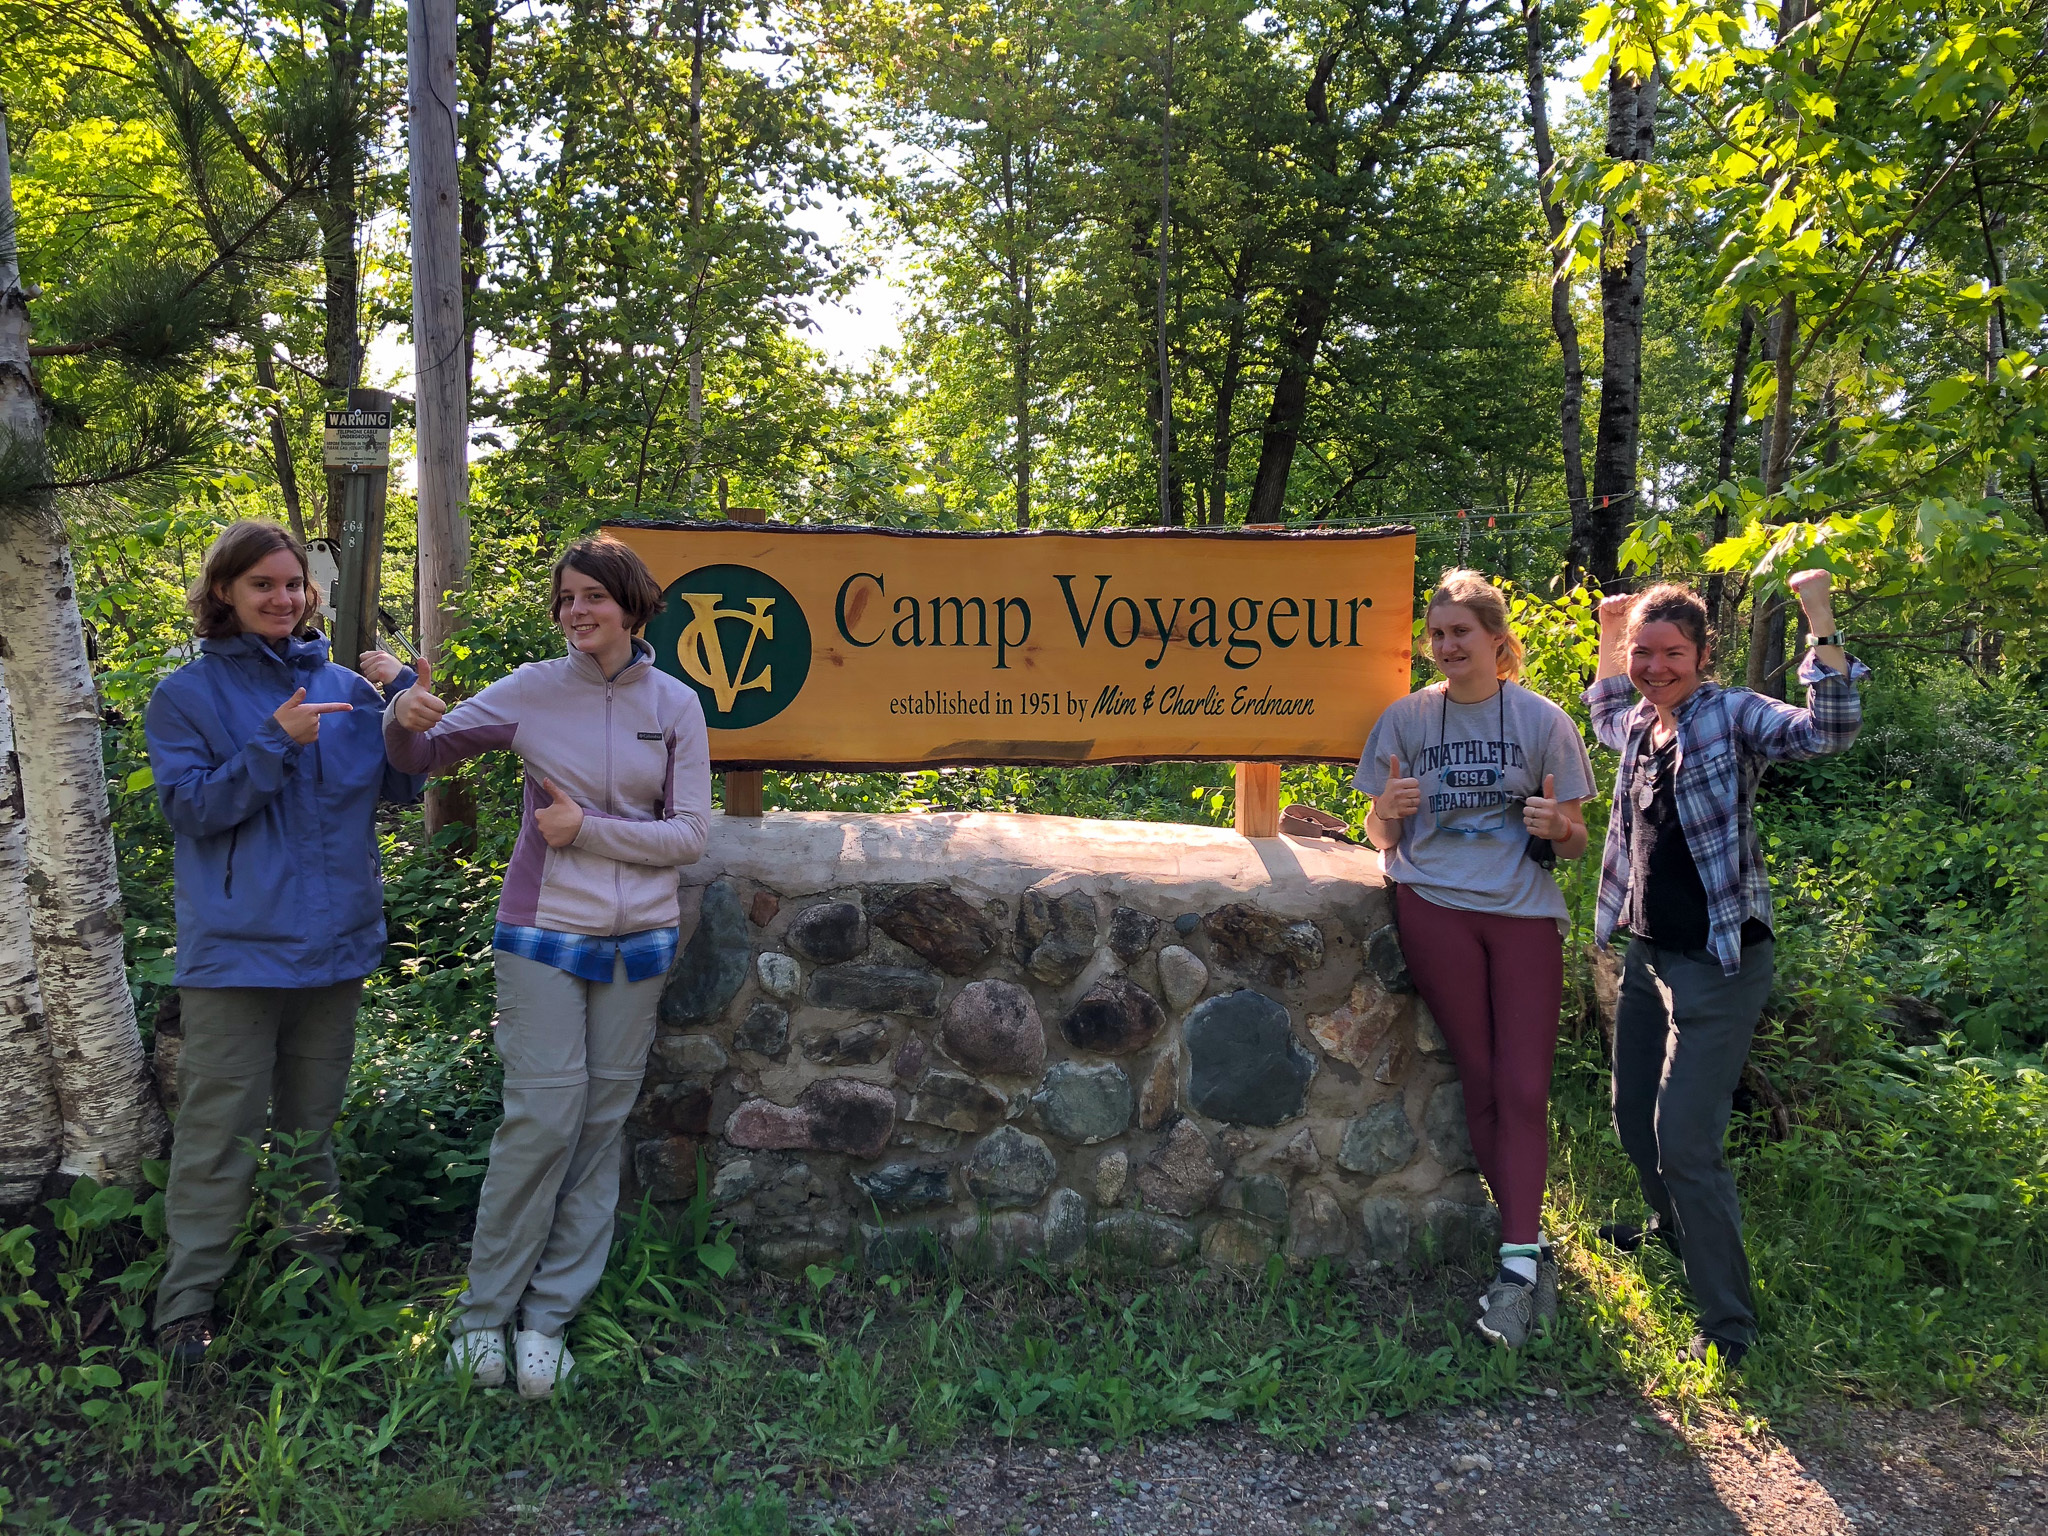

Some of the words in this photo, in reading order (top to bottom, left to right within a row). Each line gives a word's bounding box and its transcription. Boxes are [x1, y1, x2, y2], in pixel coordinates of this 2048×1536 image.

[329, 414, 387, 426] WARNING
[834, 572, 1032, 669] Camp
[1053, 574, 1373, 670] Voyageur
[889, 690, 990, 715] established
[996, 690, 1013, 715] in
[1020, 692, 1059, 716] 1951
[1067, 690, 1089, 722] by
[1090, 684, 1137, 719] Mim
[1143, 684, 1156, 716] &
[1159, 684, 1225, 716] Charlie
[1231, 684, 1315, 716] Erdmann
[1453, 770, 1489, 787] 1994
[1428, 790, 1514, 814] DEPARTMENT
